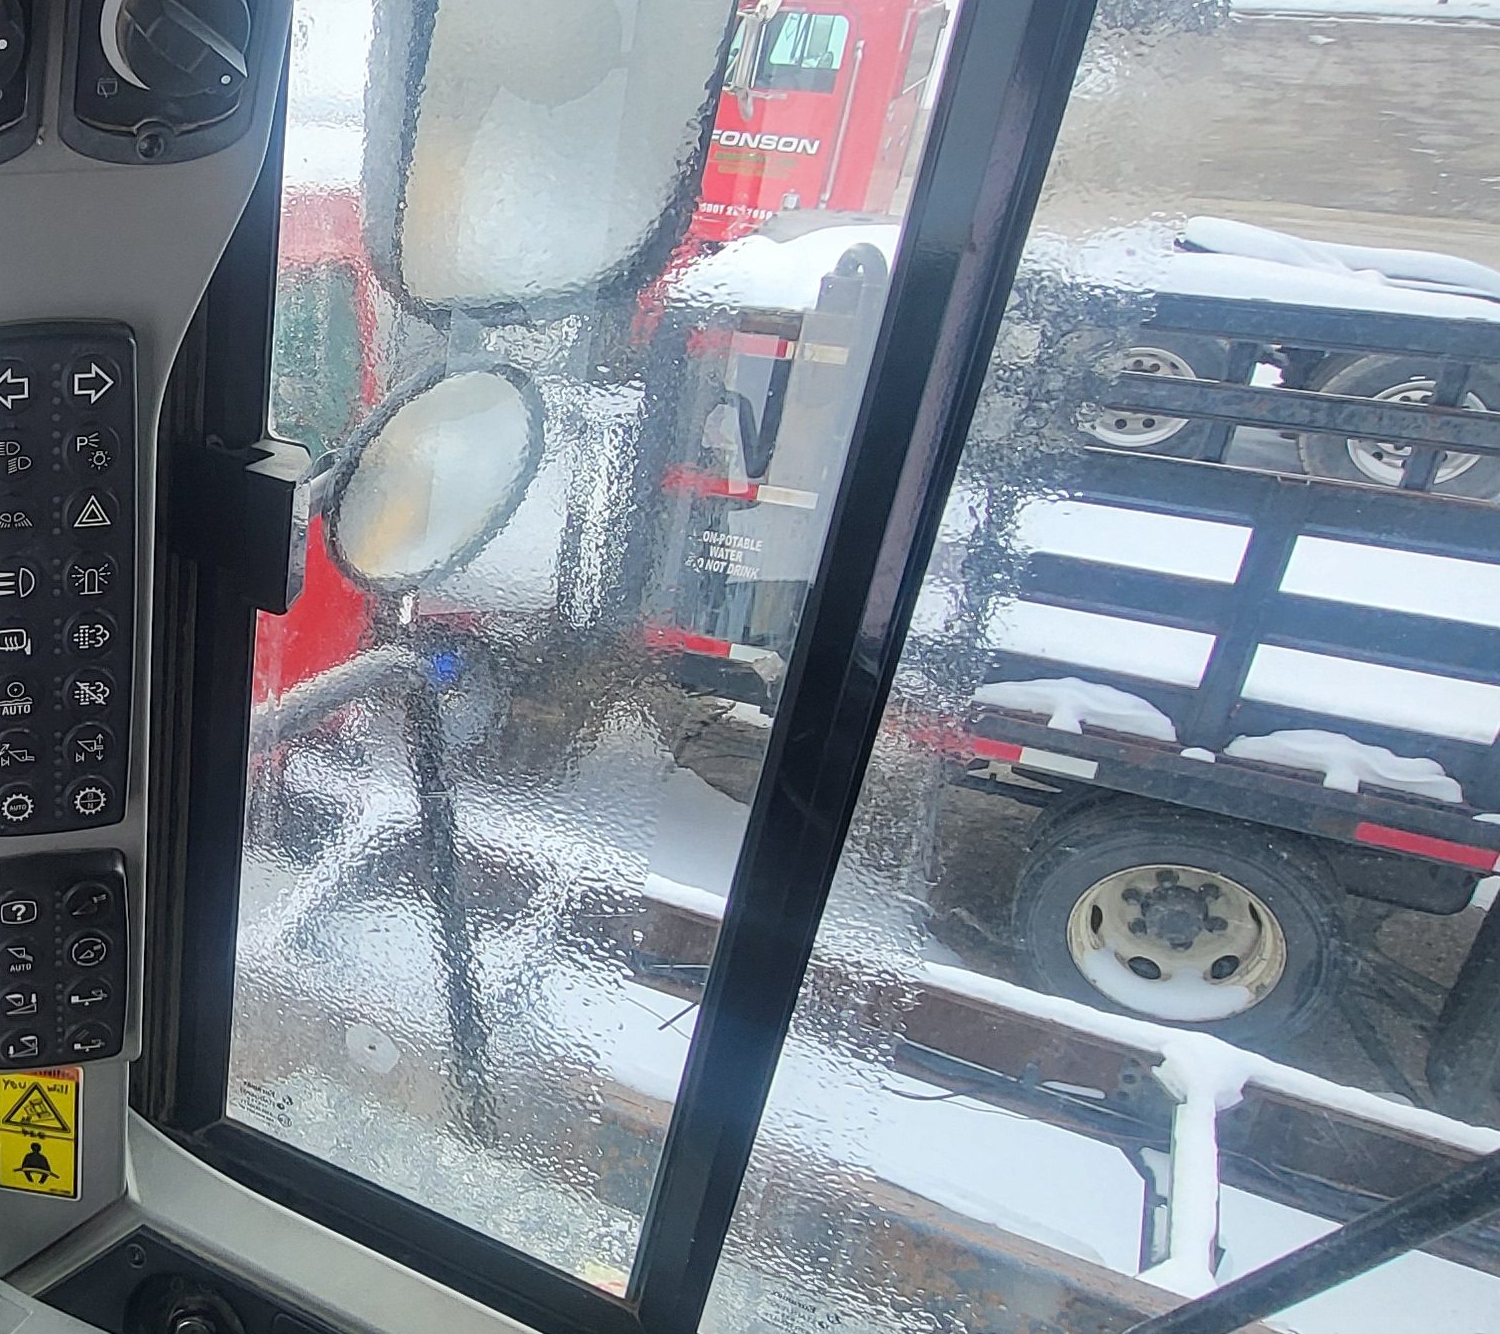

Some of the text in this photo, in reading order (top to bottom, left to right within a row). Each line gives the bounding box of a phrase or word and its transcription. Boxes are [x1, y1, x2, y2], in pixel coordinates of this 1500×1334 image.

[711, 129, 820, 155] FONSON
[709, 545, 744, 563] WATER
[704, 558, 728, 573] NOT
[726, 563, 760, 580] DRINK
[2, 704, 31, 716] AUTO
[9, 804, 27, 812] AUTO
[9, 963, 32, 973] AUTO
